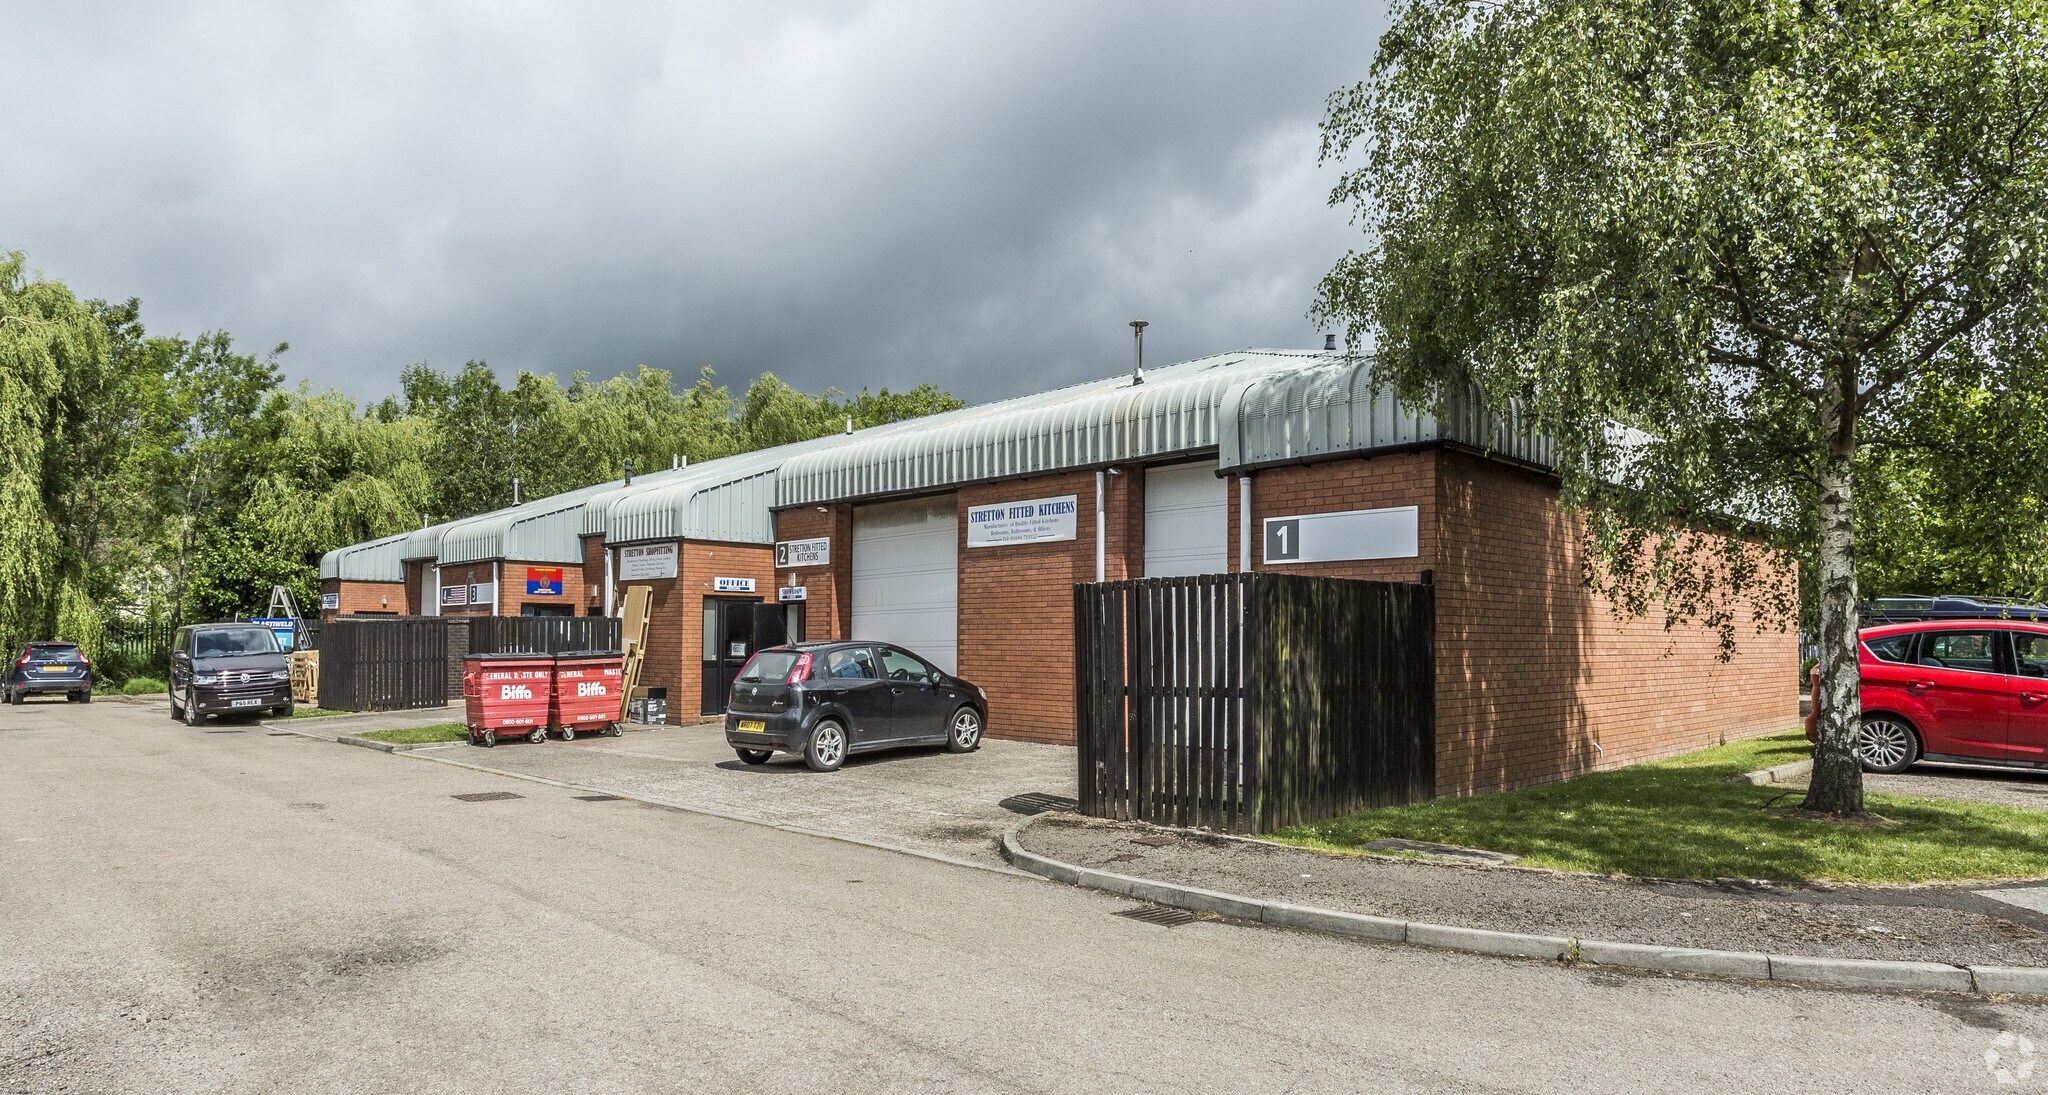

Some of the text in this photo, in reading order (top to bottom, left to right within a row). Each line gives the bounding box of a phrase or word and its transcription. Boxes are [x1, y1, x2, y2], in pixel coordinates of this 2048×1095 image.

[970, 500, 1075, 523] STRETTON FITTED KITCHENS
[1276, 525, 1288, 555] 1
[624, 545, 673, 558] STRETTON SHOPFITTING
[789, 541, 827, 554] STRETTON FITTED
[779, 546, 786, 563] 2
[796, 551, 819, 562] KITCHENS
[719, 579, 750, 587] OFFICE
[472, 588, 476, 601] 3
[534, 671, 549, 679] ONLY
[501, 684, 532, 700] Biffa
[577, 682, 606, 698] Biffa
